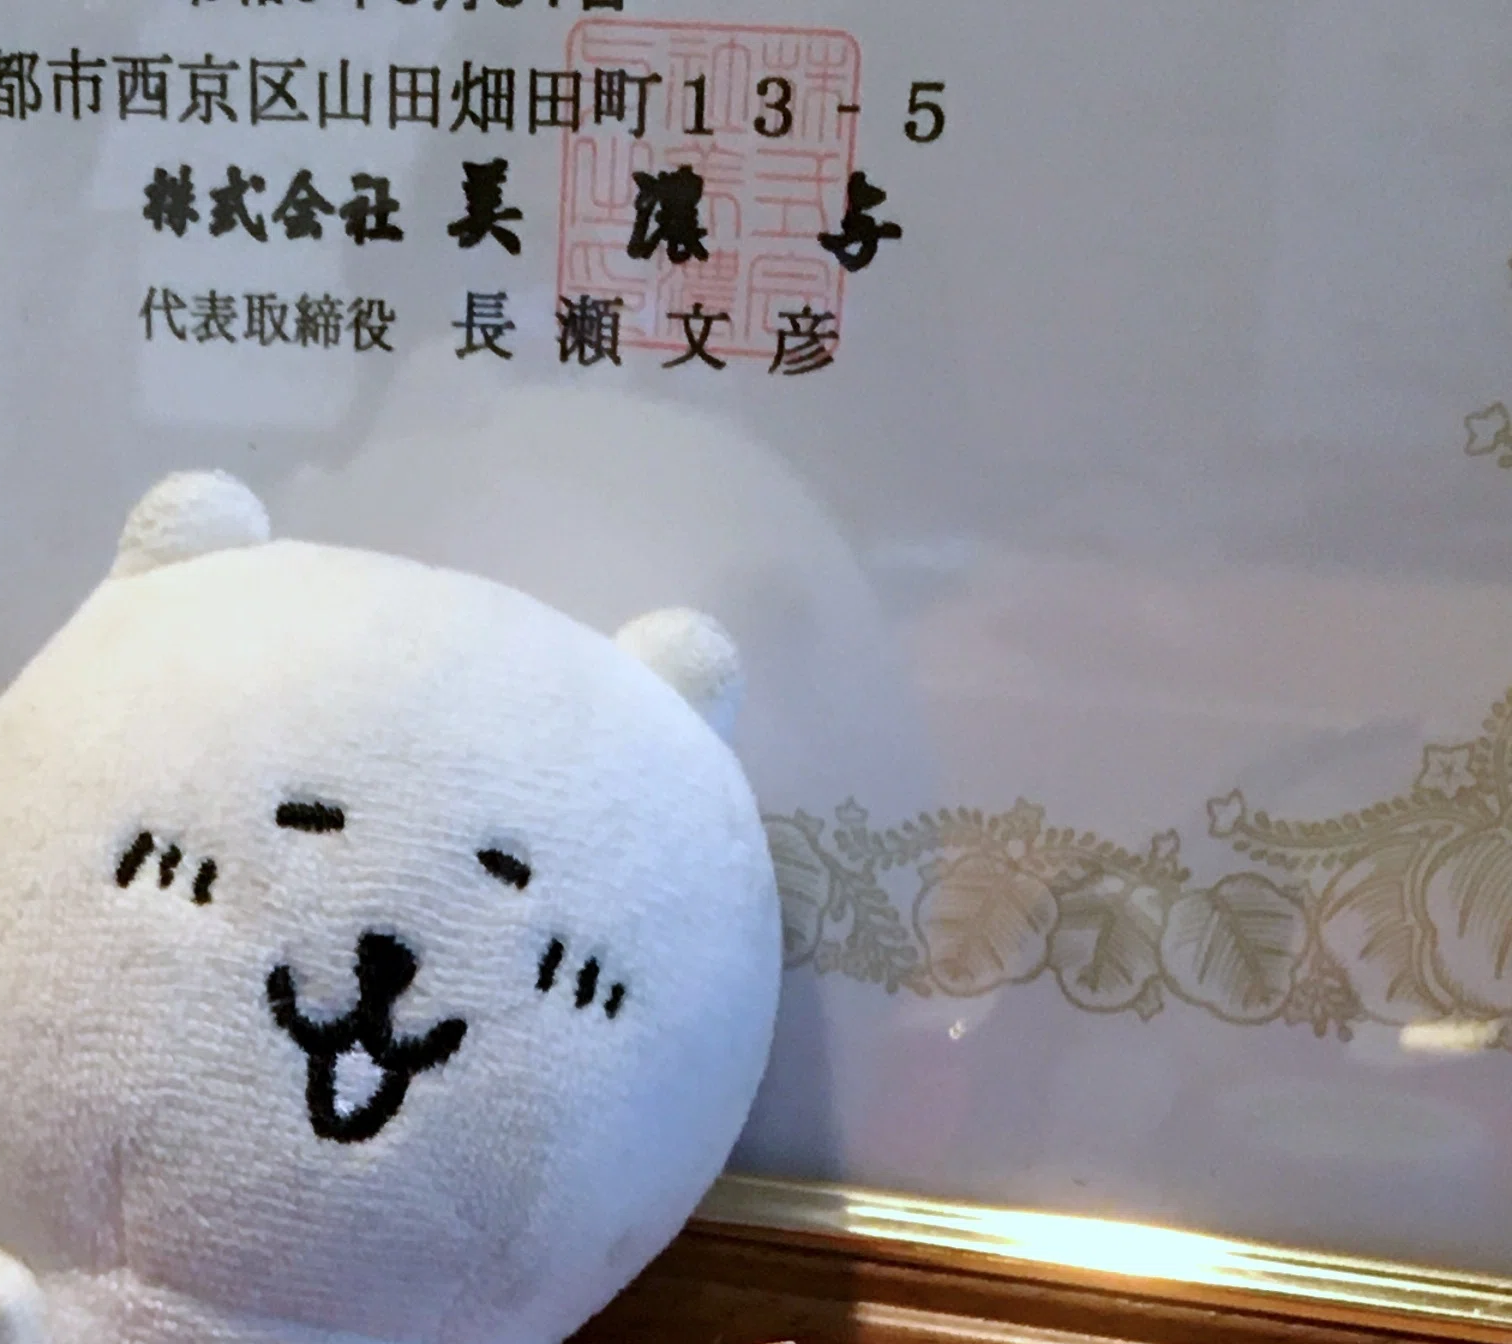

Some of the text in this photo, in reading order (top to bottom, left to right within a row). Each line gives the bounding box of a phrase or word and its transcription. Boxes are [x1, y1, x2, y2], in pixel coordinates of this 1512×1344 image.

[141, 290, 396, 353] 代表取締役
